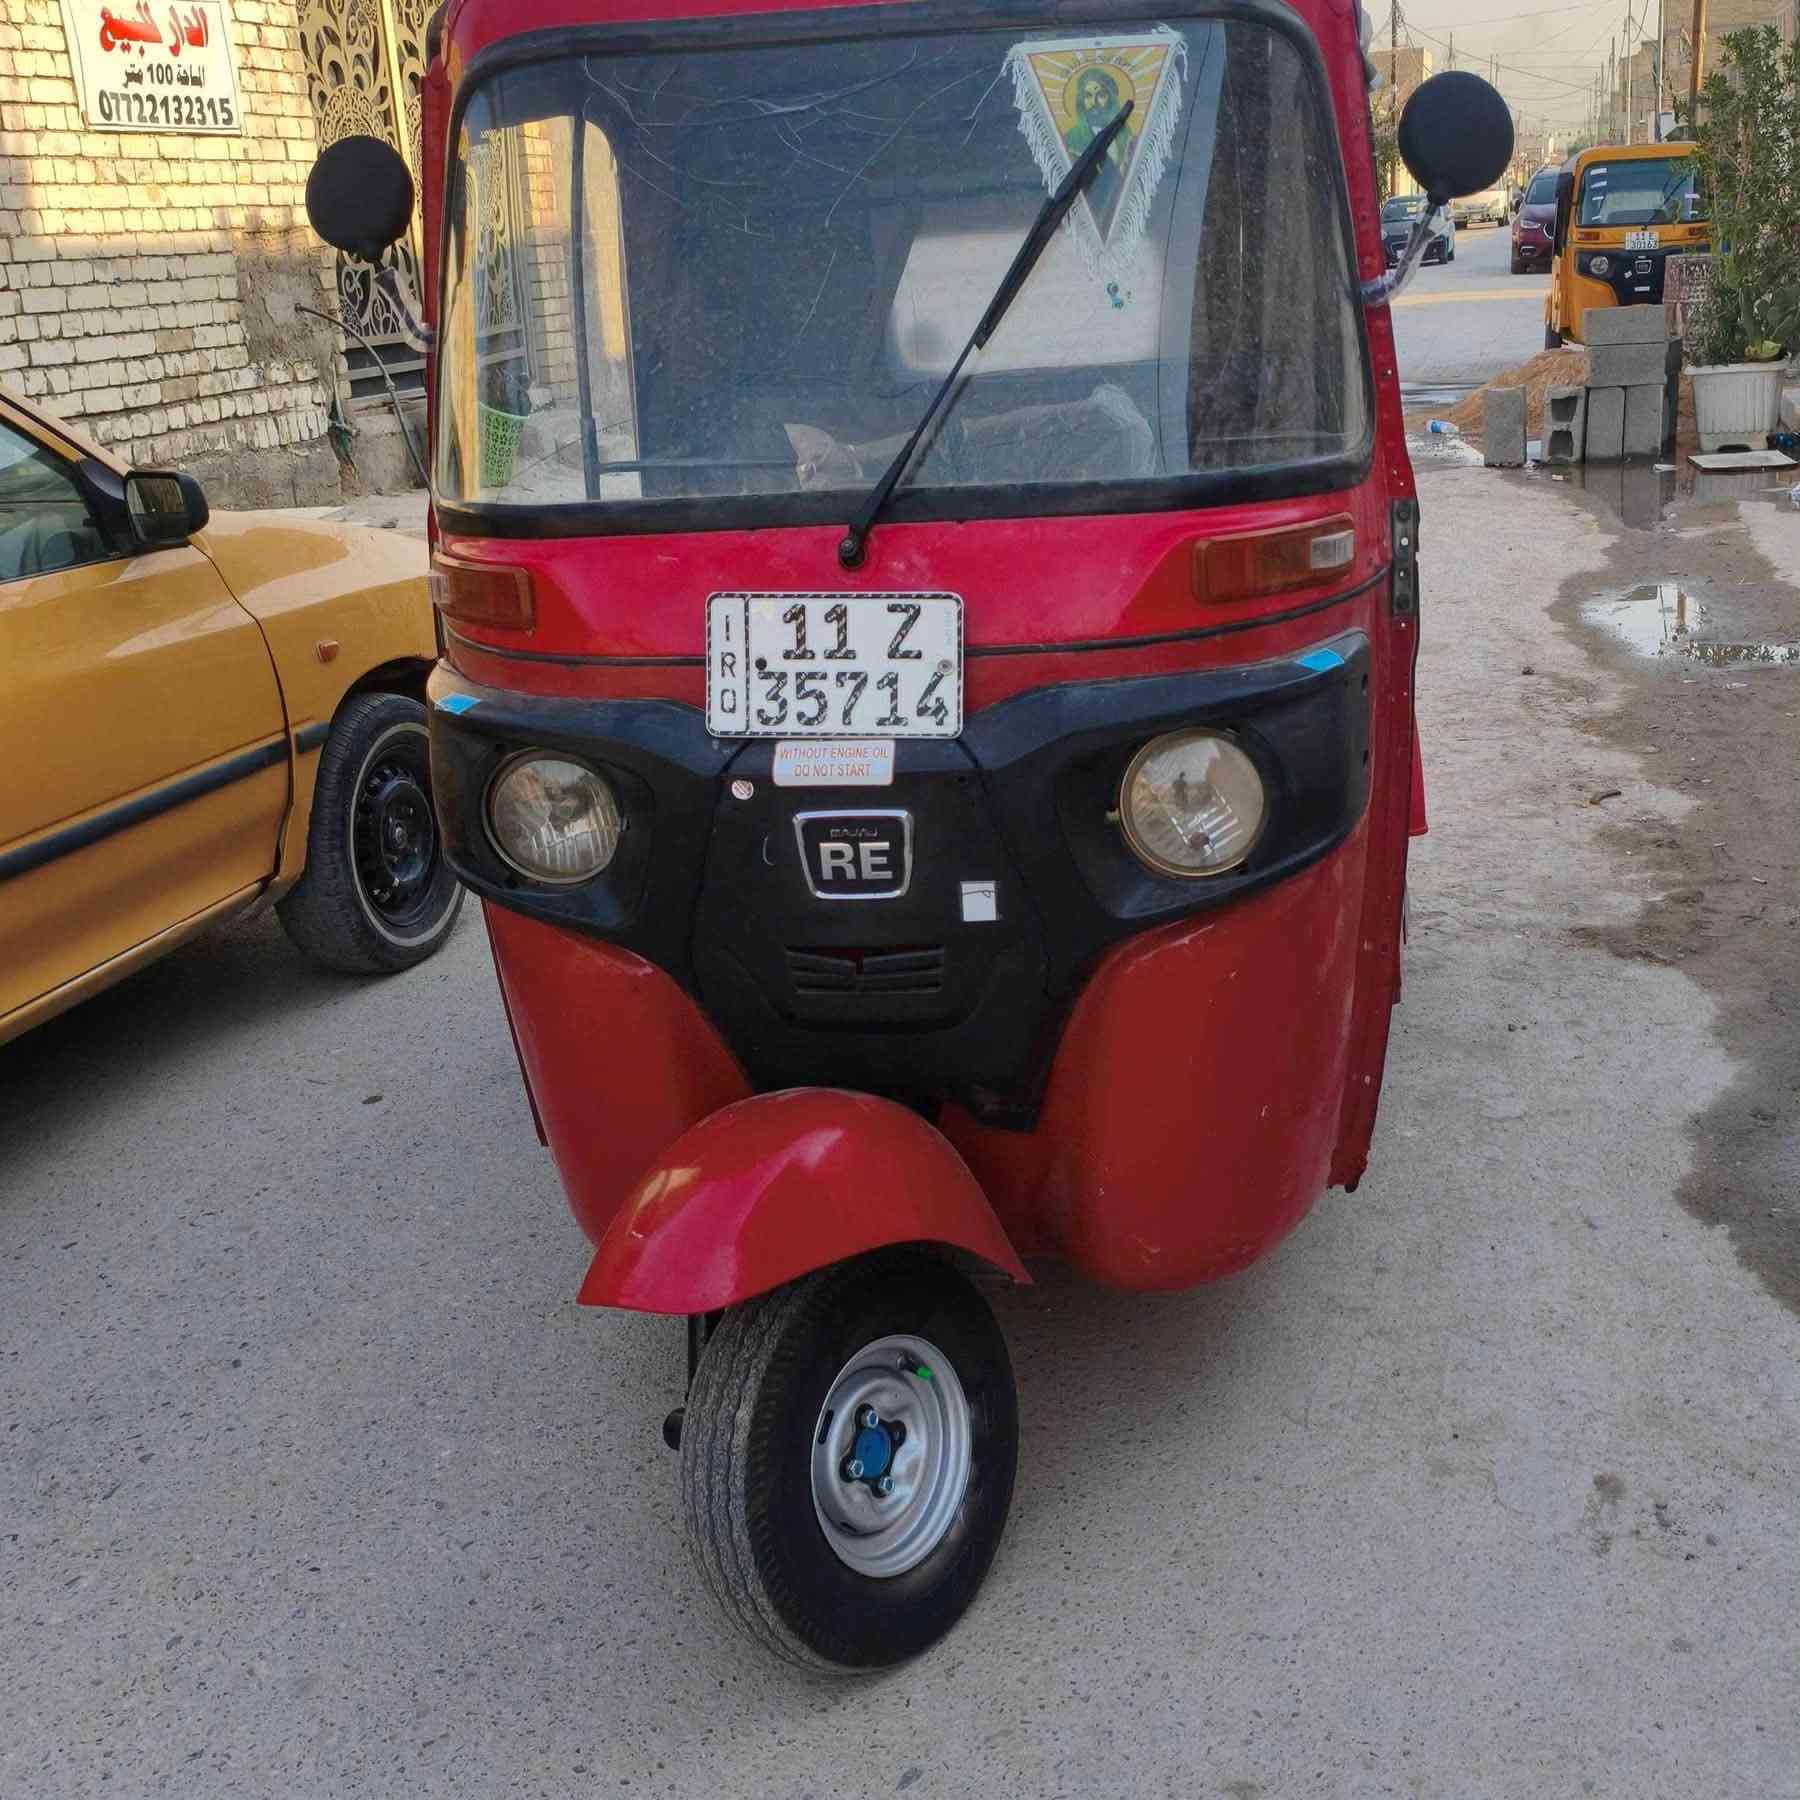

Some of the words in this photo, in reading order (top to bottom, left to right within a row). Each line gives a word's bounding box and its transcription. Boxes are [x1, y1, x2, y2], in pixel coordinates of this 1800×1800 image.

[99, 0, 163, 58] للبيع
[168, 5, 209, 58] الدار
[122, 63, 144, 89] متر
[146, 63, 174, 85] 100
[98, 89, 234, 126] 07722132315
[782, 603, 857, 660] 11
[886, 603, 923, 660] Z
[756, 671, 950, 726] 35714
[779, 747, 831, 759] WITHOUT
[831, 747, 872, 759] ENGINE
[872, 746, 889, 759] OIL
[794, 763, 810, 777] DO
[812, 763, 833, 777] NOT
[837, 763, 872, 777] START
[819, 841, 894, 880] RE
